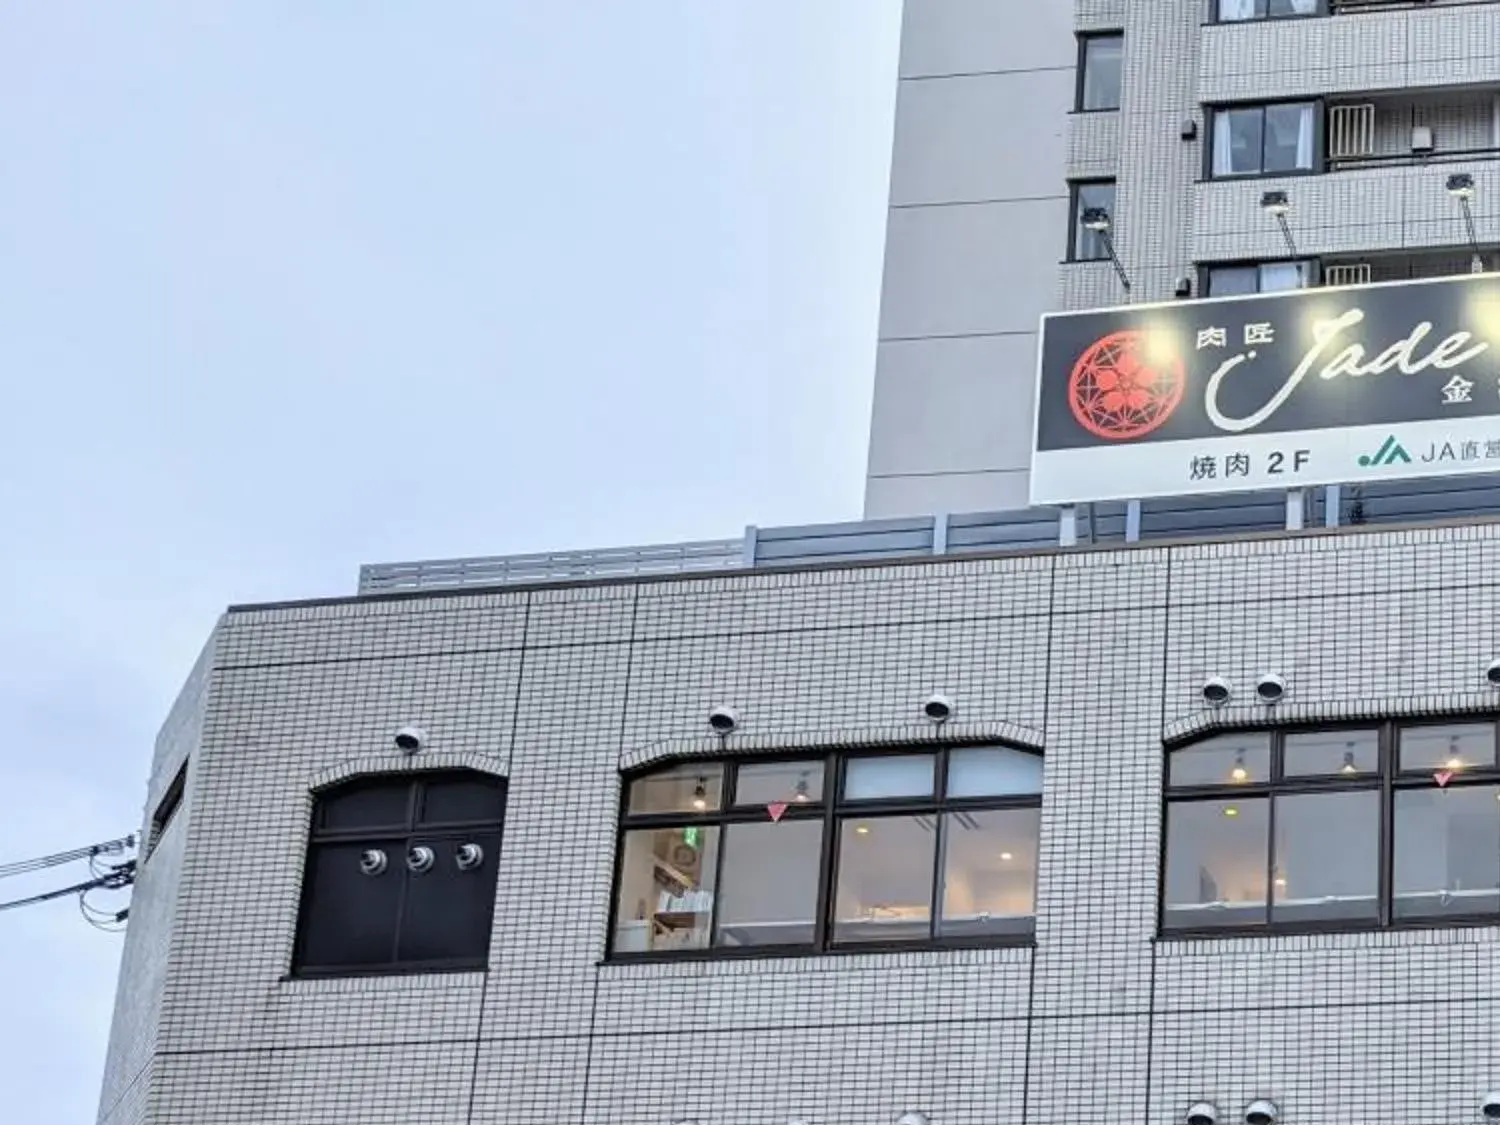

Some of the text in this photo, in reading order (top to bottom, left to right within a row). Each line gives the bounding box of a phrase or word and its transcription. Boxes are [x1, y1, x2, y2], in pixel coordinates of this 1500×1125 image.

[1195, 321, 1275, 350] 肉匠
[1204, 307, 1490, 433] Jade
[1188, 449, 1312, 481] 焼肉 2F
